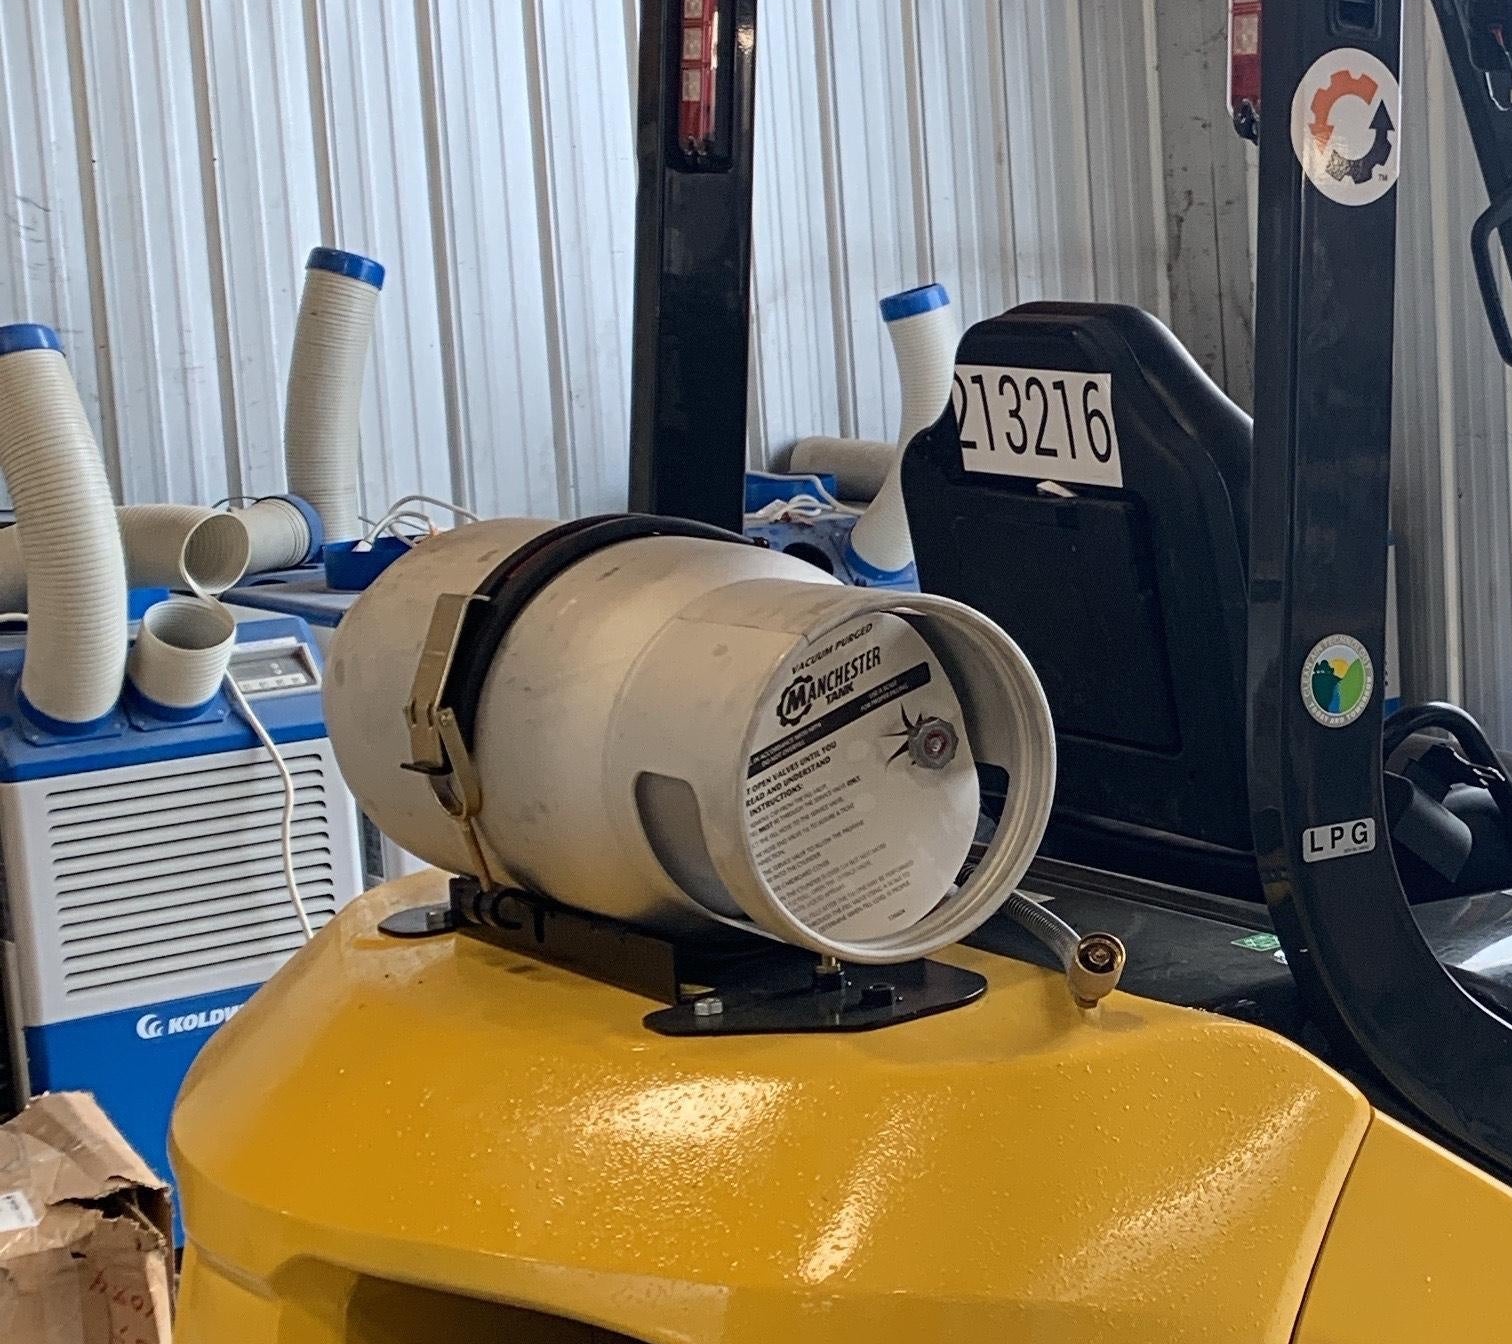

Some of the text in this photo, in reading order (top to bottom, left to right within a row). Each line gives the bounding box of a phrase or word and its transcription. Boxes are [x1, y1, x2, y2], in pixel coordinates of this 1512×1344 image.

[953, 373, 1112, 464] 213216
[791, 622, 873, 675] VACUUM PURGED
[784, 645, 882, 716] MANCHESTER
[825, 680, 855, 705] TANK
